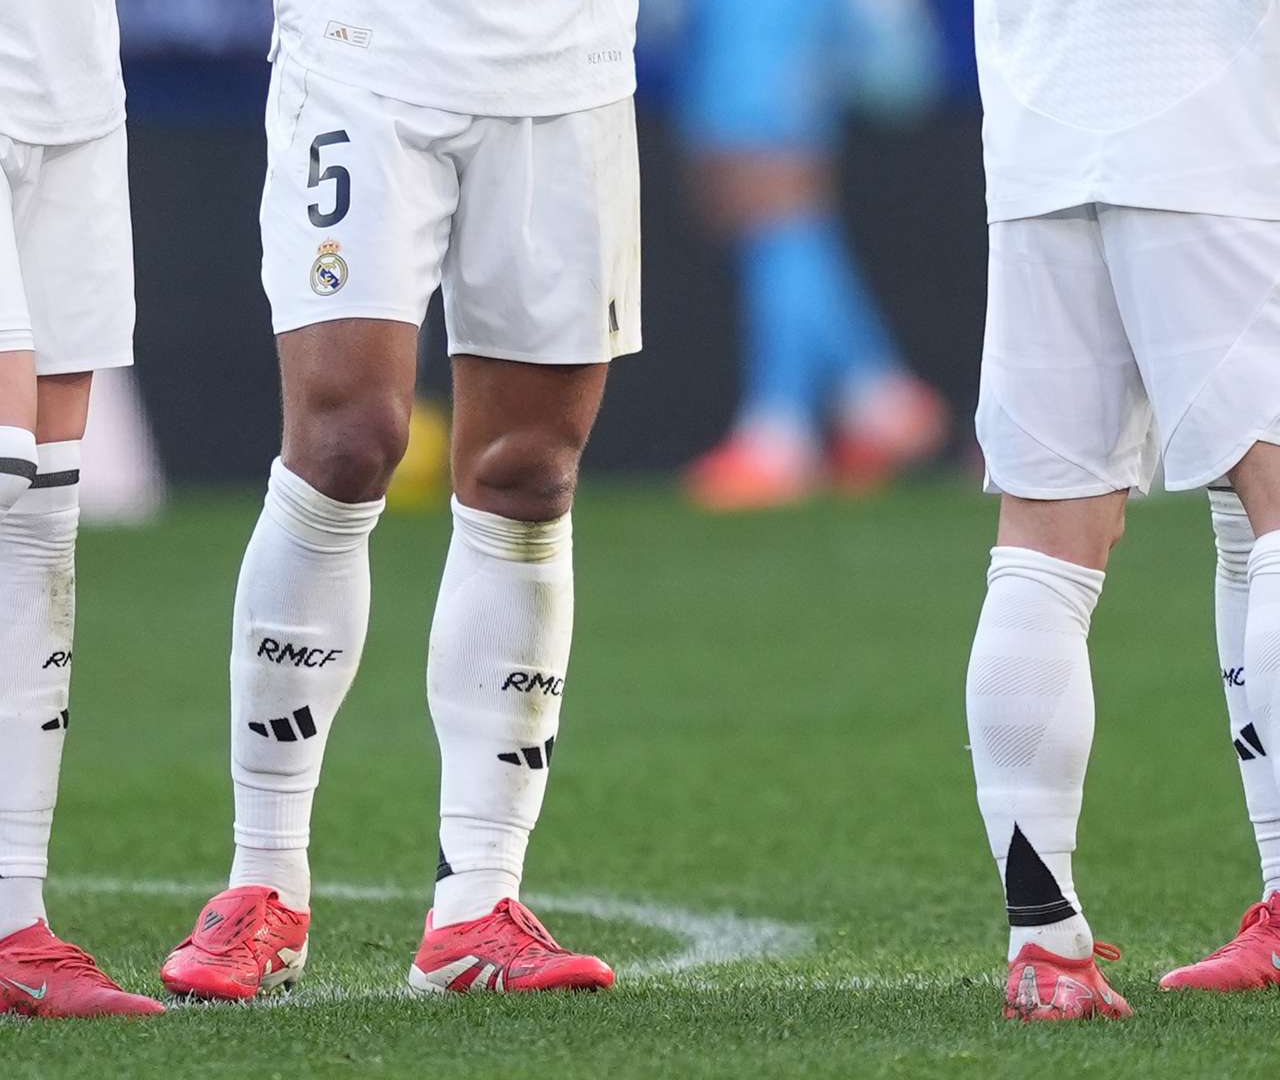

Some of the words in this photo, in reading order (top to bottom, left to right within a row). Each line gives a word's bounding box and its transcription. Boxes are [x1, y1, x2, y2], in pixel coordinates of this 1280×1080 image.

[306, 129, 352, 228] 5
[257, 637, 343, 668] RMCF
[501, 671, 564, 696] RMC
